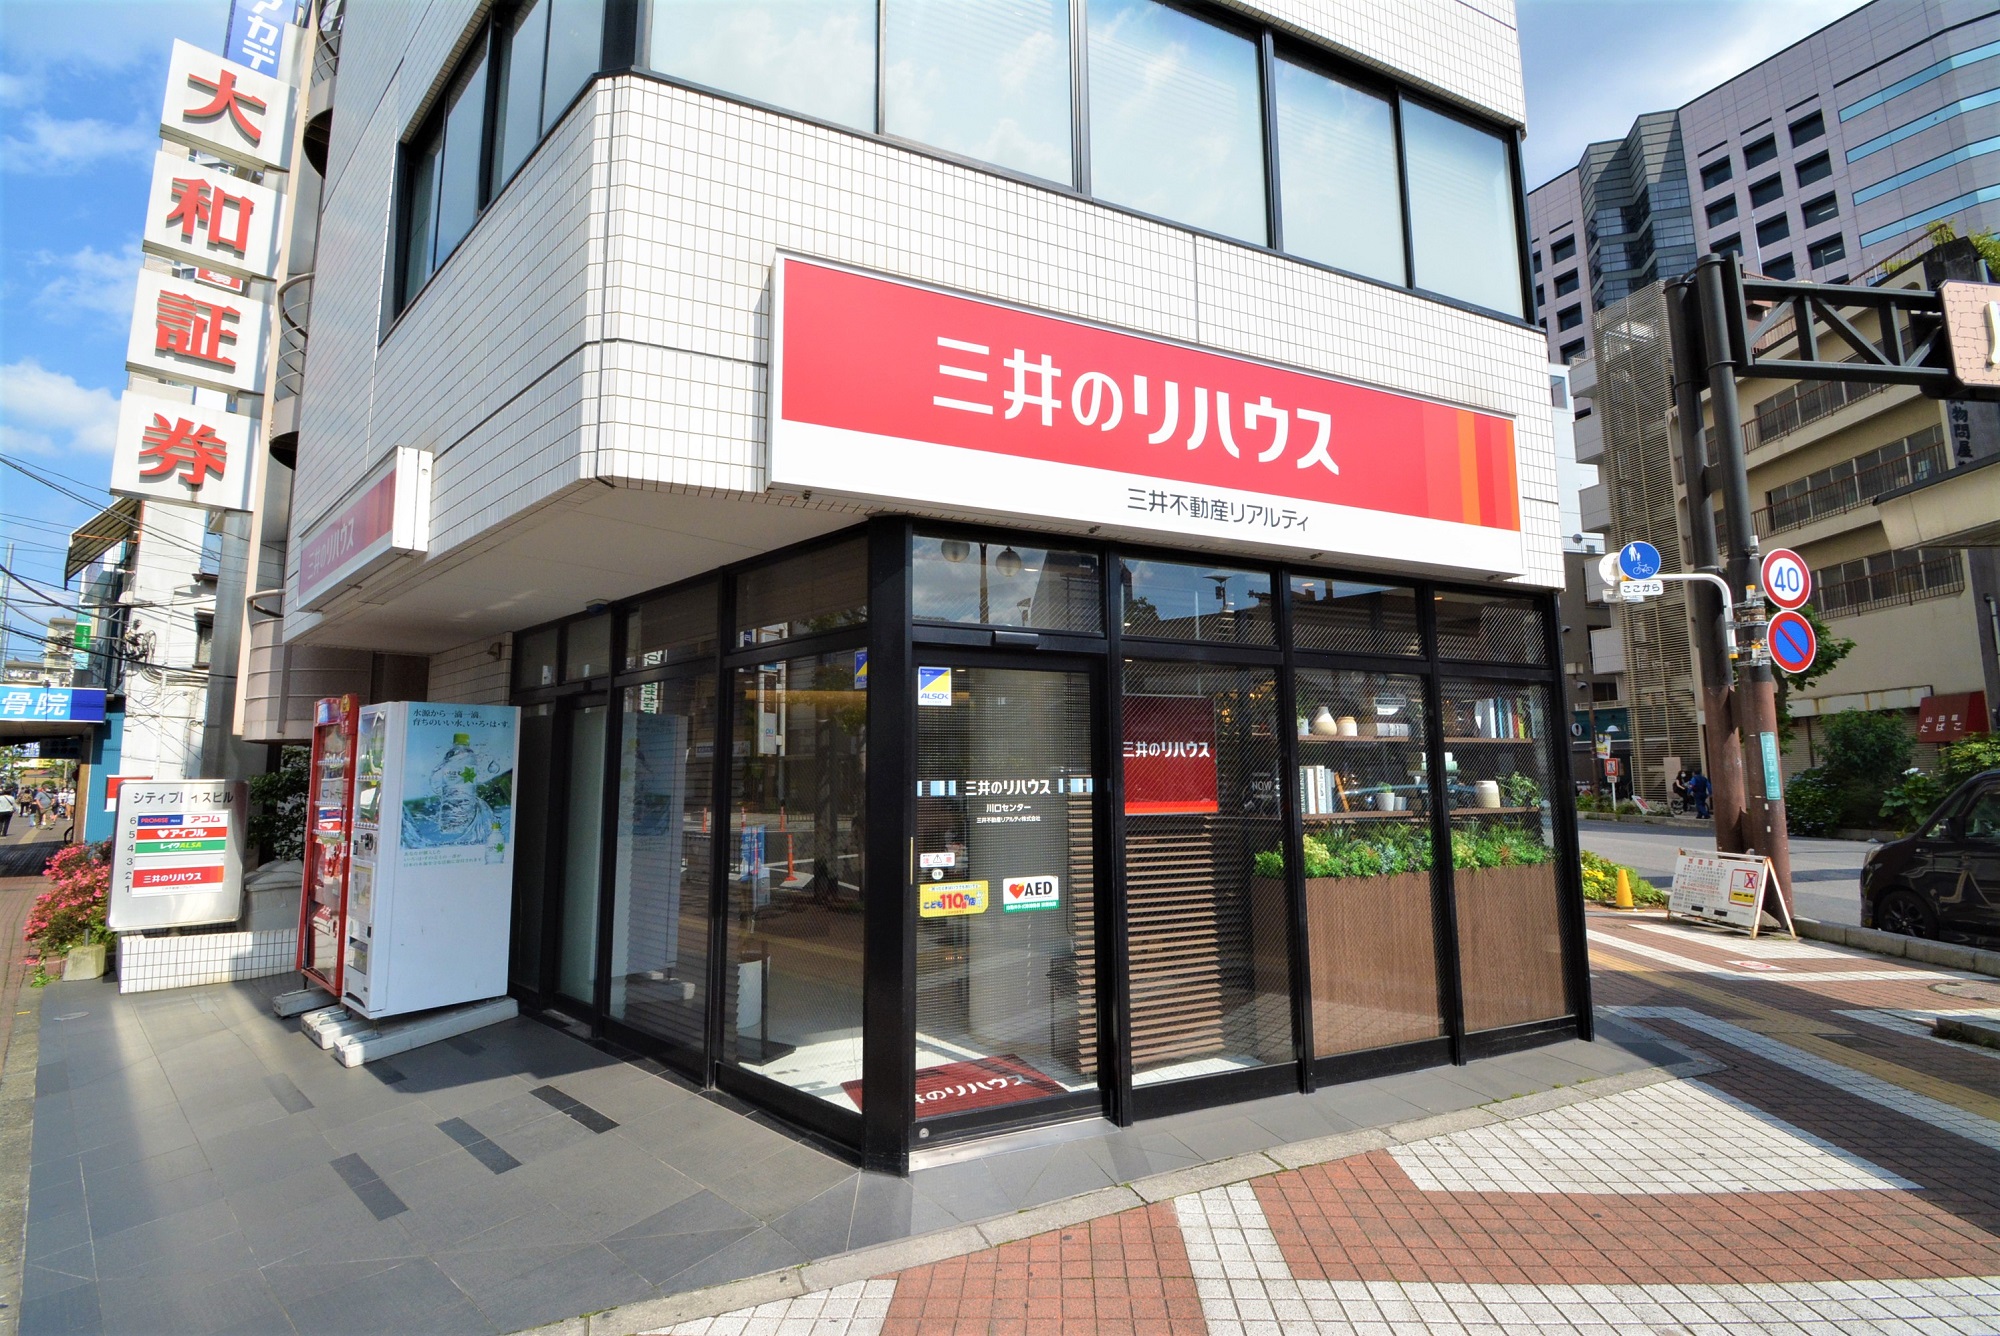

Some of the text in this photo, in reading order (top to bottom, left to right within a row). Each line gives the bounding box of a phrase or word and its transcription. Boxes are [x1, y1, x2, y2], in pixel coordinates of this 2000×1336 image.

[139, 69, 267, 486] 大和証券
[933, 335, 1340, 476] 三井のリハウス
[1126, 488, 1310, 532] 三井不動産リアルティ
[307, 517, 355, 580] 三井のリハウス
[1774, 566, 1800, 592] 40
[1623, 584, 1660, 593] ここから
[1, 691, 70, 716] 骨院
[1920, 723, 1962, 733] たばこ
[1123, 741, 1210, 758] 三井のリハウス
[965, 778, 1051, 796] 三井のリハウス
[133, 791, 234, 804] シティプイスビル
[986, 803, 1032, 813] 川口センター
[130, 816, 137, 825] 6
[190, 815, 221, 824] アコム
[976, 815, 1041, 824] 三井不動産リアルティ株式会社
[129, 831, 136, 839] 5
[169, 828, 208, 837] アイフル
[127, 844, 134, 852] 4
[126, 857, 133, 866] 3
[125, 871, 132, 880] 2
[143, 872, 202, 884] 三井のリハウス
[125, 885, 130, 893] 1
[1024, 881, 1053, 896] AED
